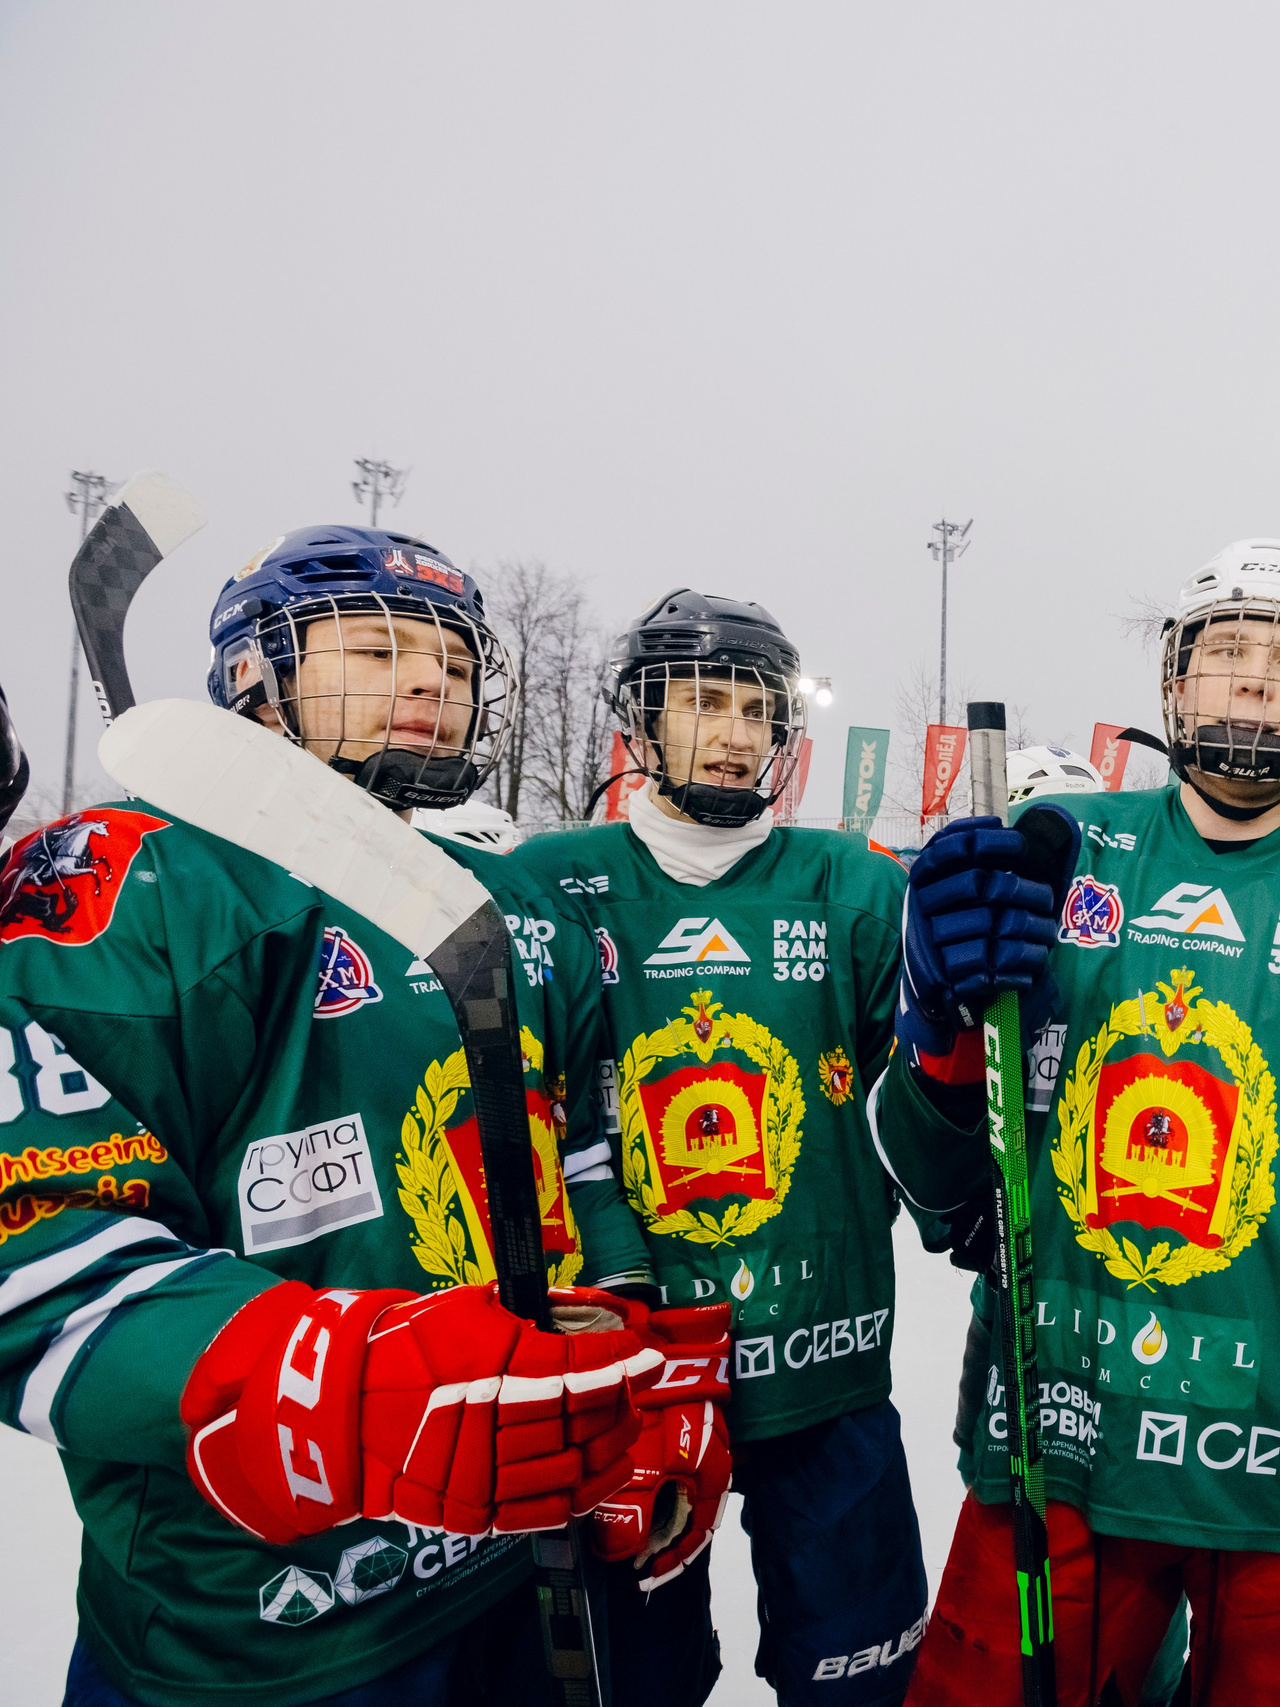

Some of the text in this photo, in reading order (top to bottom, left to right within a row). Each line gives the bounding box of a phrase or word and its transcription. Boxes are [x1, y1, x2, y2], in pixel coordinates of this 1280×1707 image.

[928, 734, 958, 812] КОЛЁД
[1127, 928, 1245, 959] TRADING COMPANY
[643, 965, 752, 979] TRADING COMPANY
[773, 961, 825, 982] 360
[983, 1021, 1006, 1154] CCM
[246, 1150, 364, 1213] СОФТ
[783, 1307, 890, 1370] СЕВЕР
[593, 1510, 635, 1524] CCM
